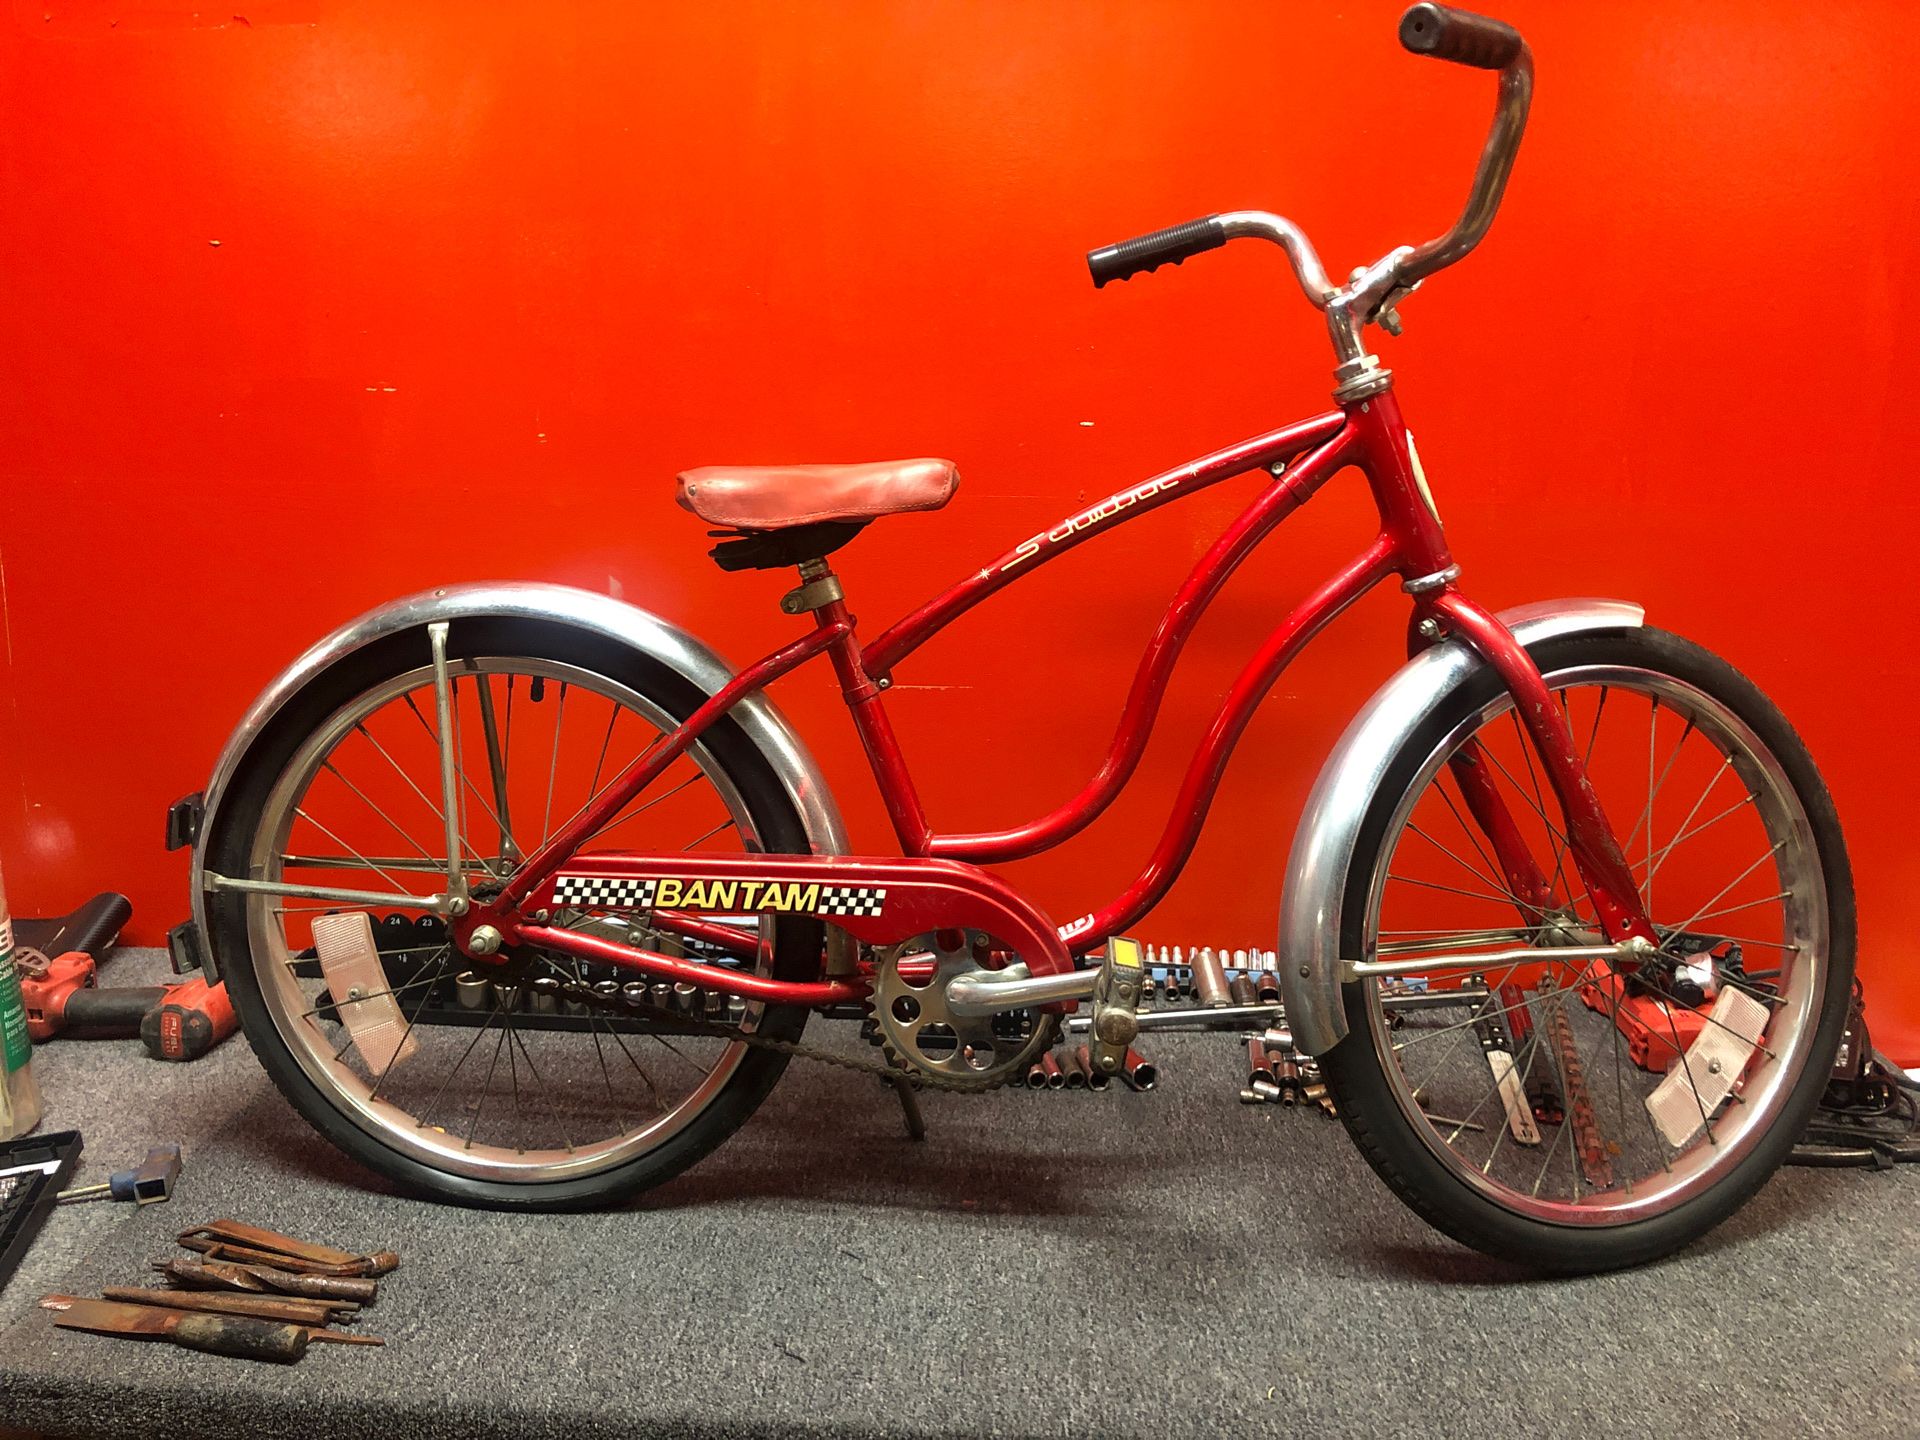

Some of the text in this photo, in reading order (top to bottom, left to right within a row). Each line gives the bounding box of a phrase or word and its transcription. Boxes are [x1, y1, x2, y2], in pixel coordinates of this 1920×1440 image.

[654, 878, 820, 913] BANTAM
[390, 917, 401, 925] 24
[422, 918, 433, 927] 23
